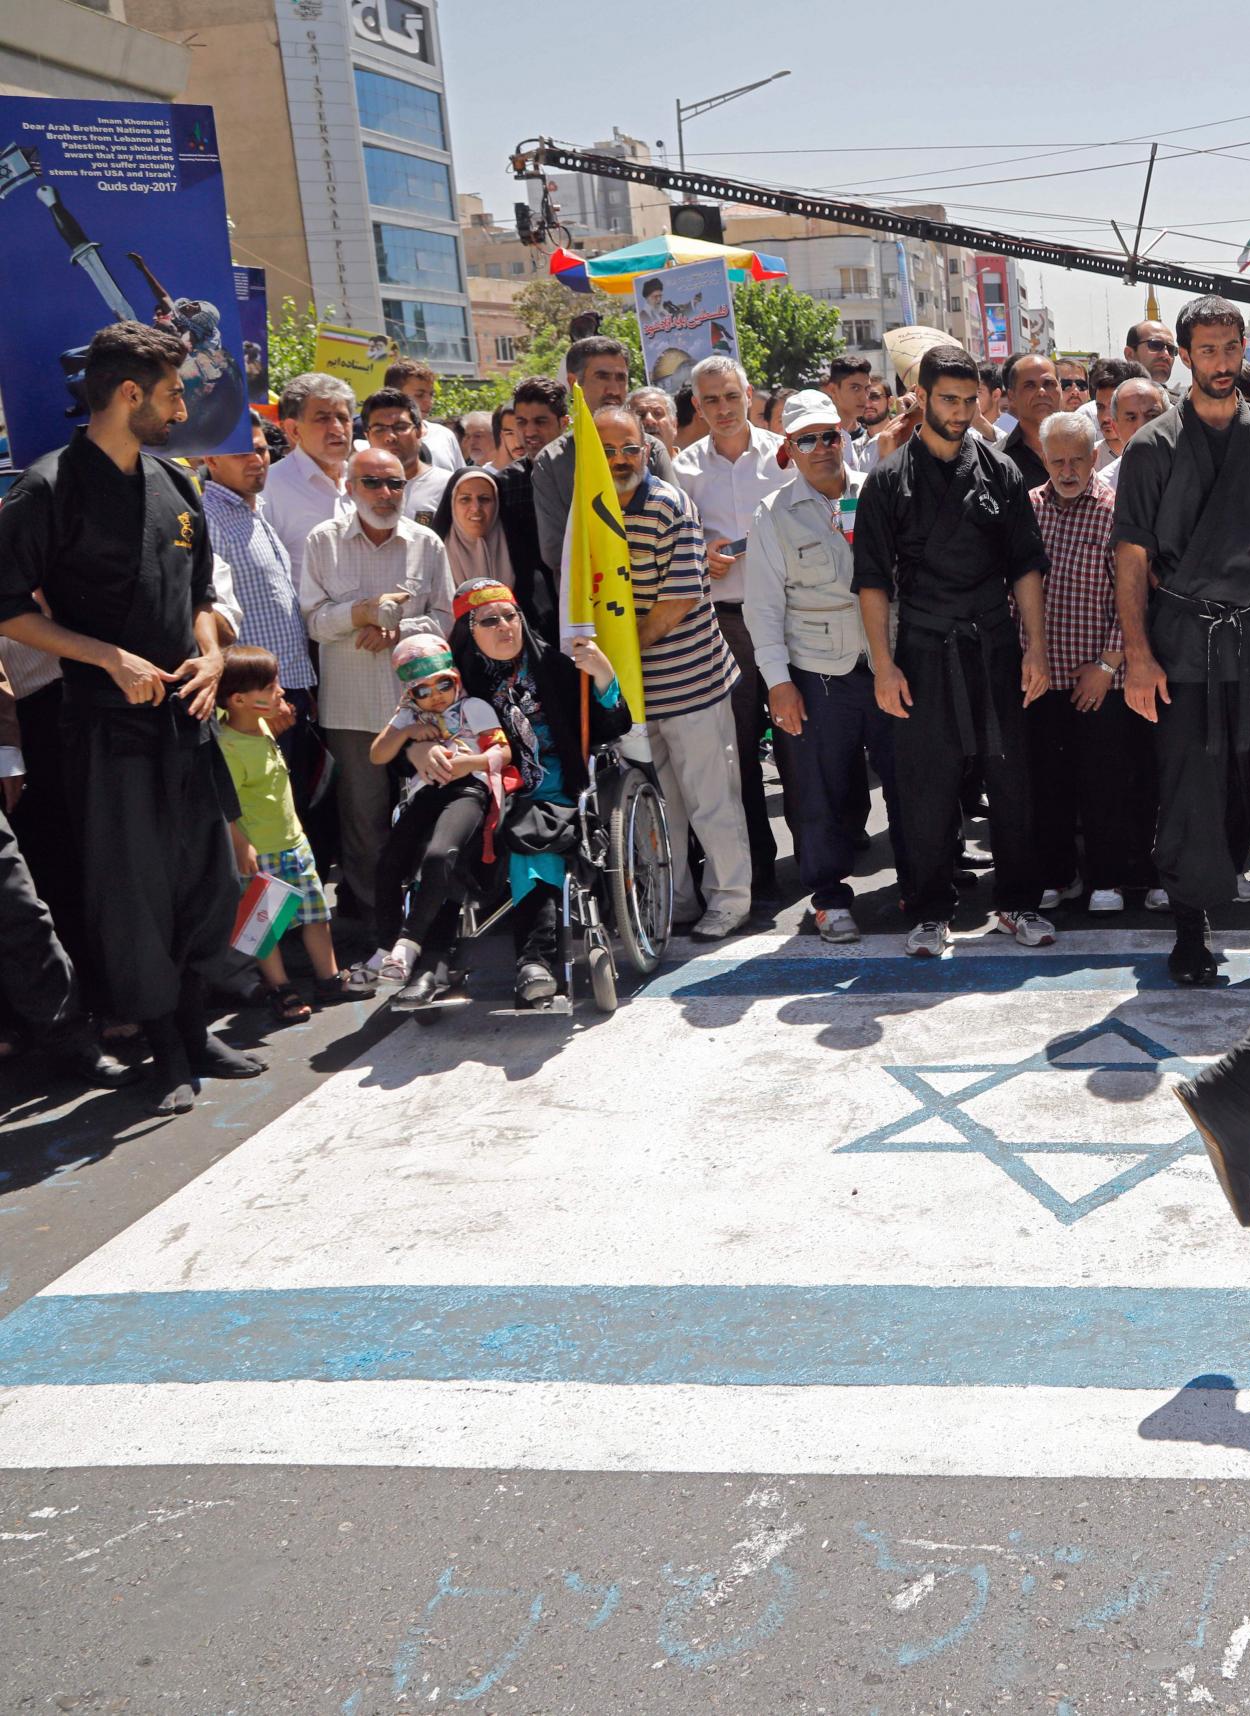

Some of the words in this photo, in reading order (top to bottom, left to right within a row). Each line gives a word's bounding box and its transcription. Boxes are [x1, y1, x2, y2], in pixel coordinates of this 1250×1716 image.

[124, 118, 163, 126] Khomeini
[22, 122, 45, 130] Dear
[48, 123, 70, 131] Arab
[73, 125, 114, 133] Brethren
[116, 126, 151, 134] Nations
[46, 133, 87, 141] Brothers
[90, 134, 111, 142] from
[114, 135, 152, 143] Lebanon
[62, 143, 108, 151] Palestine,
[130, 144, 159, 152] should
[313, 75, 341, 230] INTERNATIONAL
[139, 162, 175, 170] actually
[98, 181, 127, 191] Quds
[130, 182, 176, 193] day-2017
